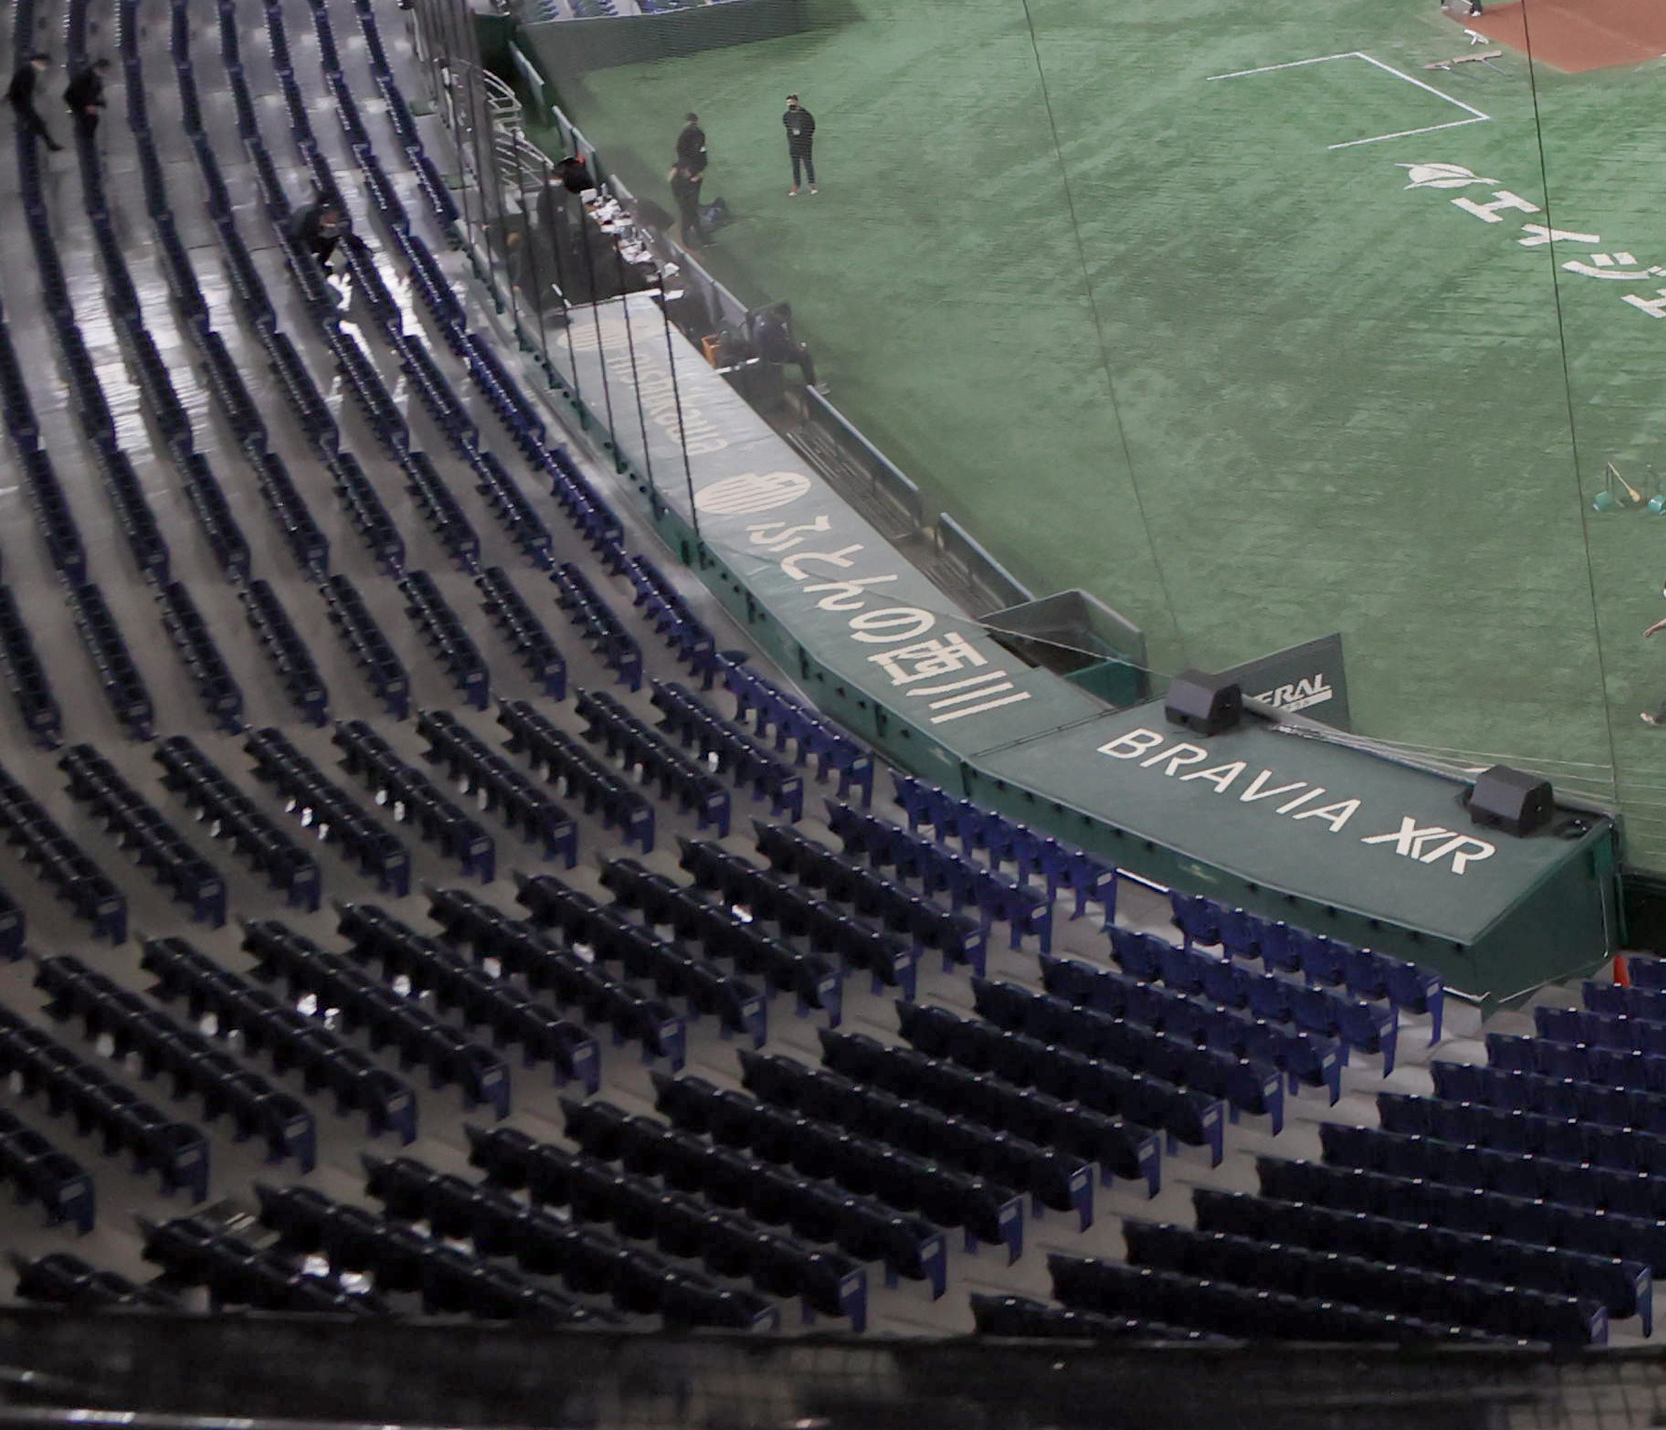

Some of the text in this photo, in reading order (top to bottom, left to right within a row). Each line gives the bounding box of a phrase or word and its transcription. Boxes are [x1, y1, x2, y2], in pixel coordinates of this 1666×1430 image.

[745, 514, 1031, 724] ふとんの西川
[1252, 673, 1331, 708] ERAL
[1097, 727, 1496, 875] BRAVIA XR
